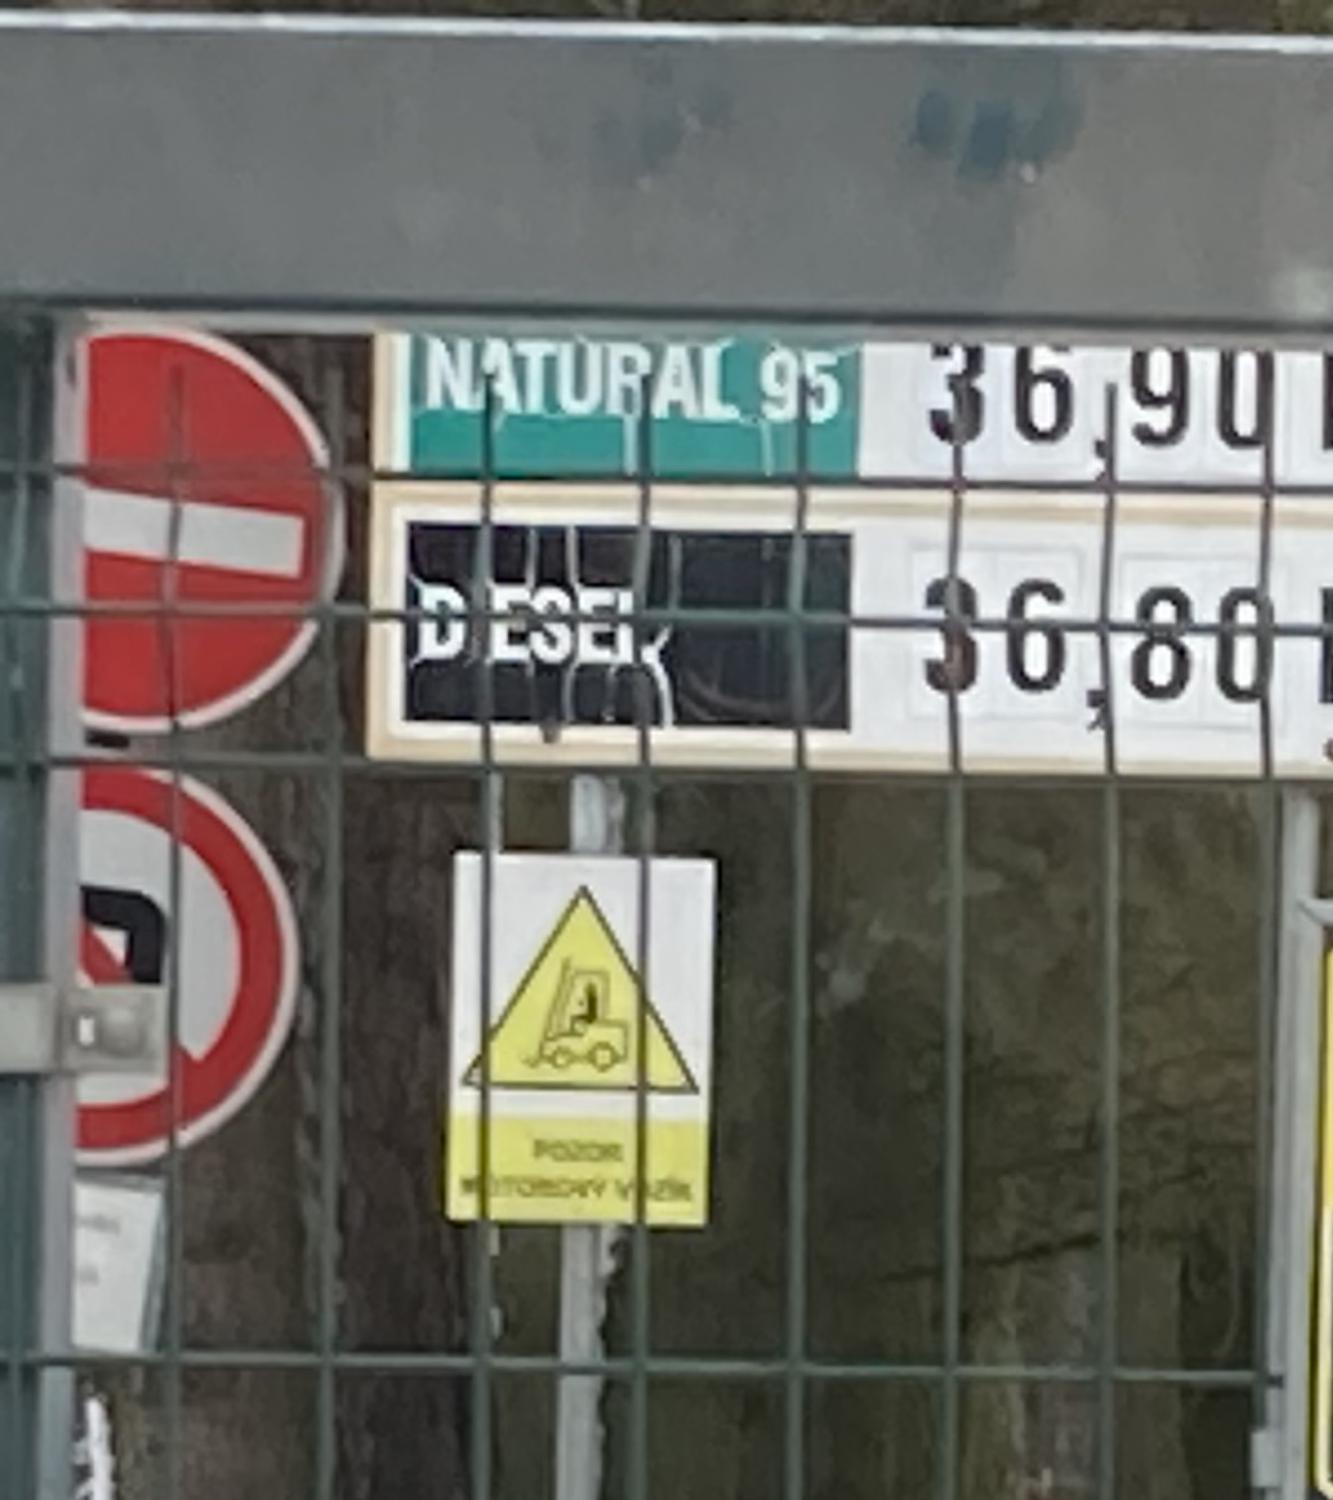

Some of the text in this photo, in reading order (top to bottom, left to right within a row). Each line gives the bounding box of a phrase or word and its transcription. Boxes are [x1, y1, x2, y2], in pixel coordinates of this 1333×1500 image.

[426, 336, 741, 421] NATURAL
[760, 344, 842, 424] 95
[928, 345, 1275, 480] 36,90
[418, 583, 661, 664] DESEL
[924, 577, 1275, 731] 36,80
